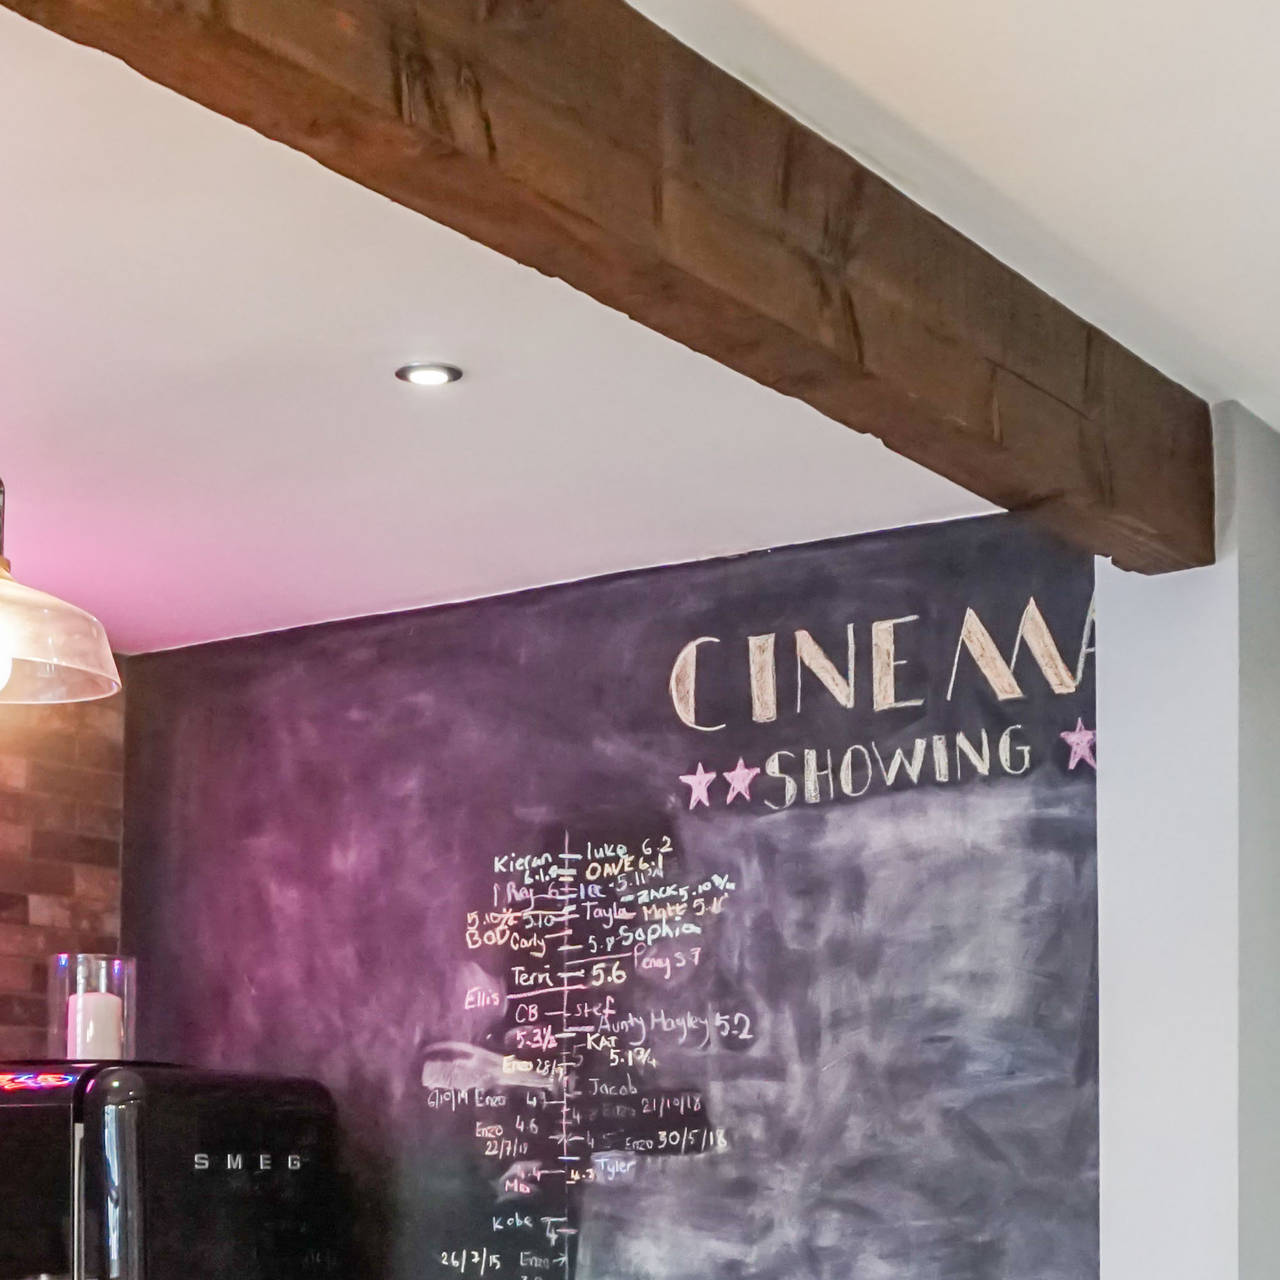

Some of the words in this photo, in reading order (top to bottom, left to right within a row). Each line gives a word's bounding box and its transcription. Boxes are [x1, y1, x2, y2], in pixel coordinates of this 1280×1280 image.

[764, 725, 1031, 810] SHOWING
[641, 835, 673, 855] 6.2
[494, 853, 552, 873] Kieran
[511, 964, 554, 986] Terri
[591, 961, 627, 987] 5.6
[464, 986, 500, 1010] Ellis
[515, 1003, 539, 1023] CB
[598, 1012, 647, 1046] Aunty
[586, 1032, 619, 1051] KAT
[588, 1073, 638, 1096] Jacob
[475, 1087, 507, 1107] Enzo
[476, 1121, 504, 1138] Enzo
[658, 1127, 728, 1155] 30/5/18
[194, 1153, 301, 1170] SMEG
[595, 1158, 637, 1181] Tyler
[440, 1248, 501, 1276] 26/7/15
